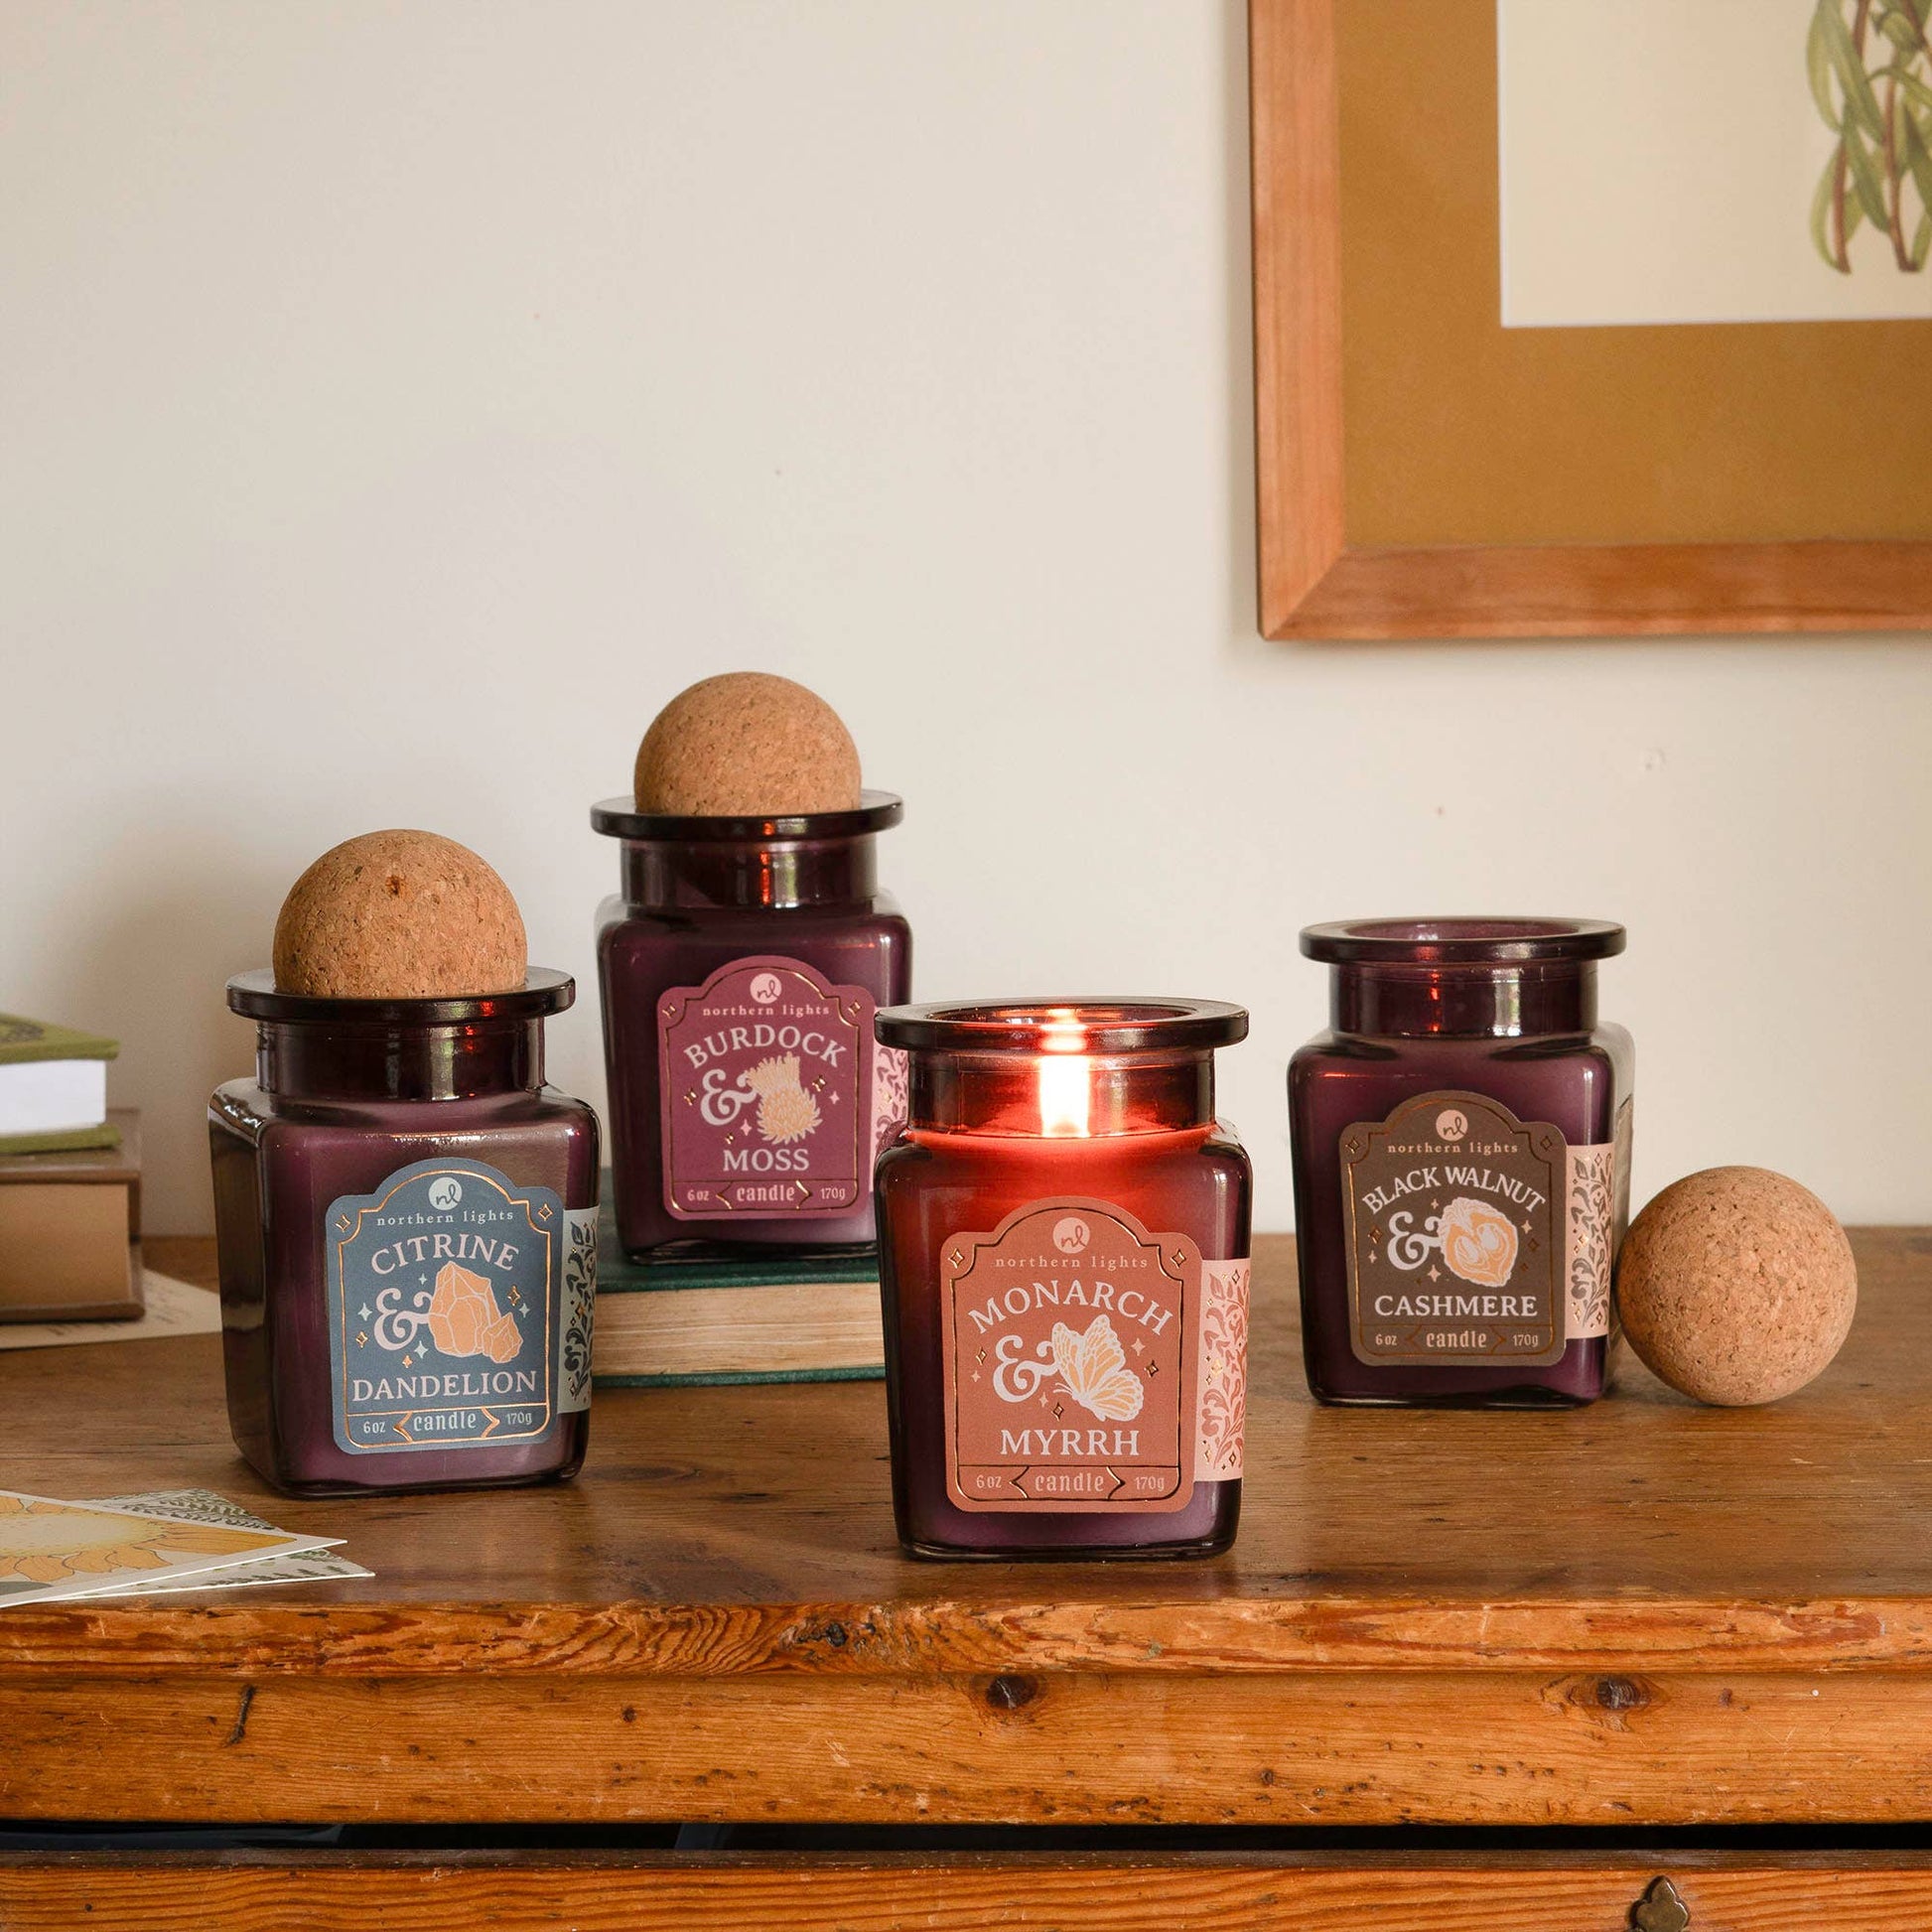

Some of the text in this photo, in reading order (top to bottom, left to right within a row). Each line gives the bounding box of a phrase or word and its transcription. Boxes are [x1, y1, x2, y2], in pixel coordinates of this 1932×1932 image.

[703, 1005, 829, 1018] northern lights
[684, 1024, 847, 1068] BURDOCK
[701, 1069, 758, 1126] &
[723, 1149, 810, 1173] MOSS
[1388, 1143, 1518, 1156] northern lights
[737, 1185, 795, 1201] candle
[821, 1187, 845, 1200] 170g
[1362, 1166, 1546, 1215] BLACK WALNUT
[377, 1210, 513, 1226] northern lights
[1388, 1211, 1442, 1271] &
[371, 1233, 519, 1275] CITRINE
[994, 1256, 1148, 1271] northern lights
[374, 1288, 434, 1350] &
[968, 1279, 1173, 1336] MONARCH
[1375, 1296, 1538, 1317] CASHMERE
[1427, 1330, 1487, 1348] candle
[1513, 1334, 1539, 1347] 170g
[993, 1335, 1059, 1403] &
[352, 1370, 537, 1402] DANDELION
[414, 1411, 477, 1431] candle
[506, 1413, 532, 1426] 170g
[1000, 1429, 1140, 1456] MYRRH
[1035, 1470, 1104, 1492] candle
[1135, 1475, 1165, 1491] 170g
